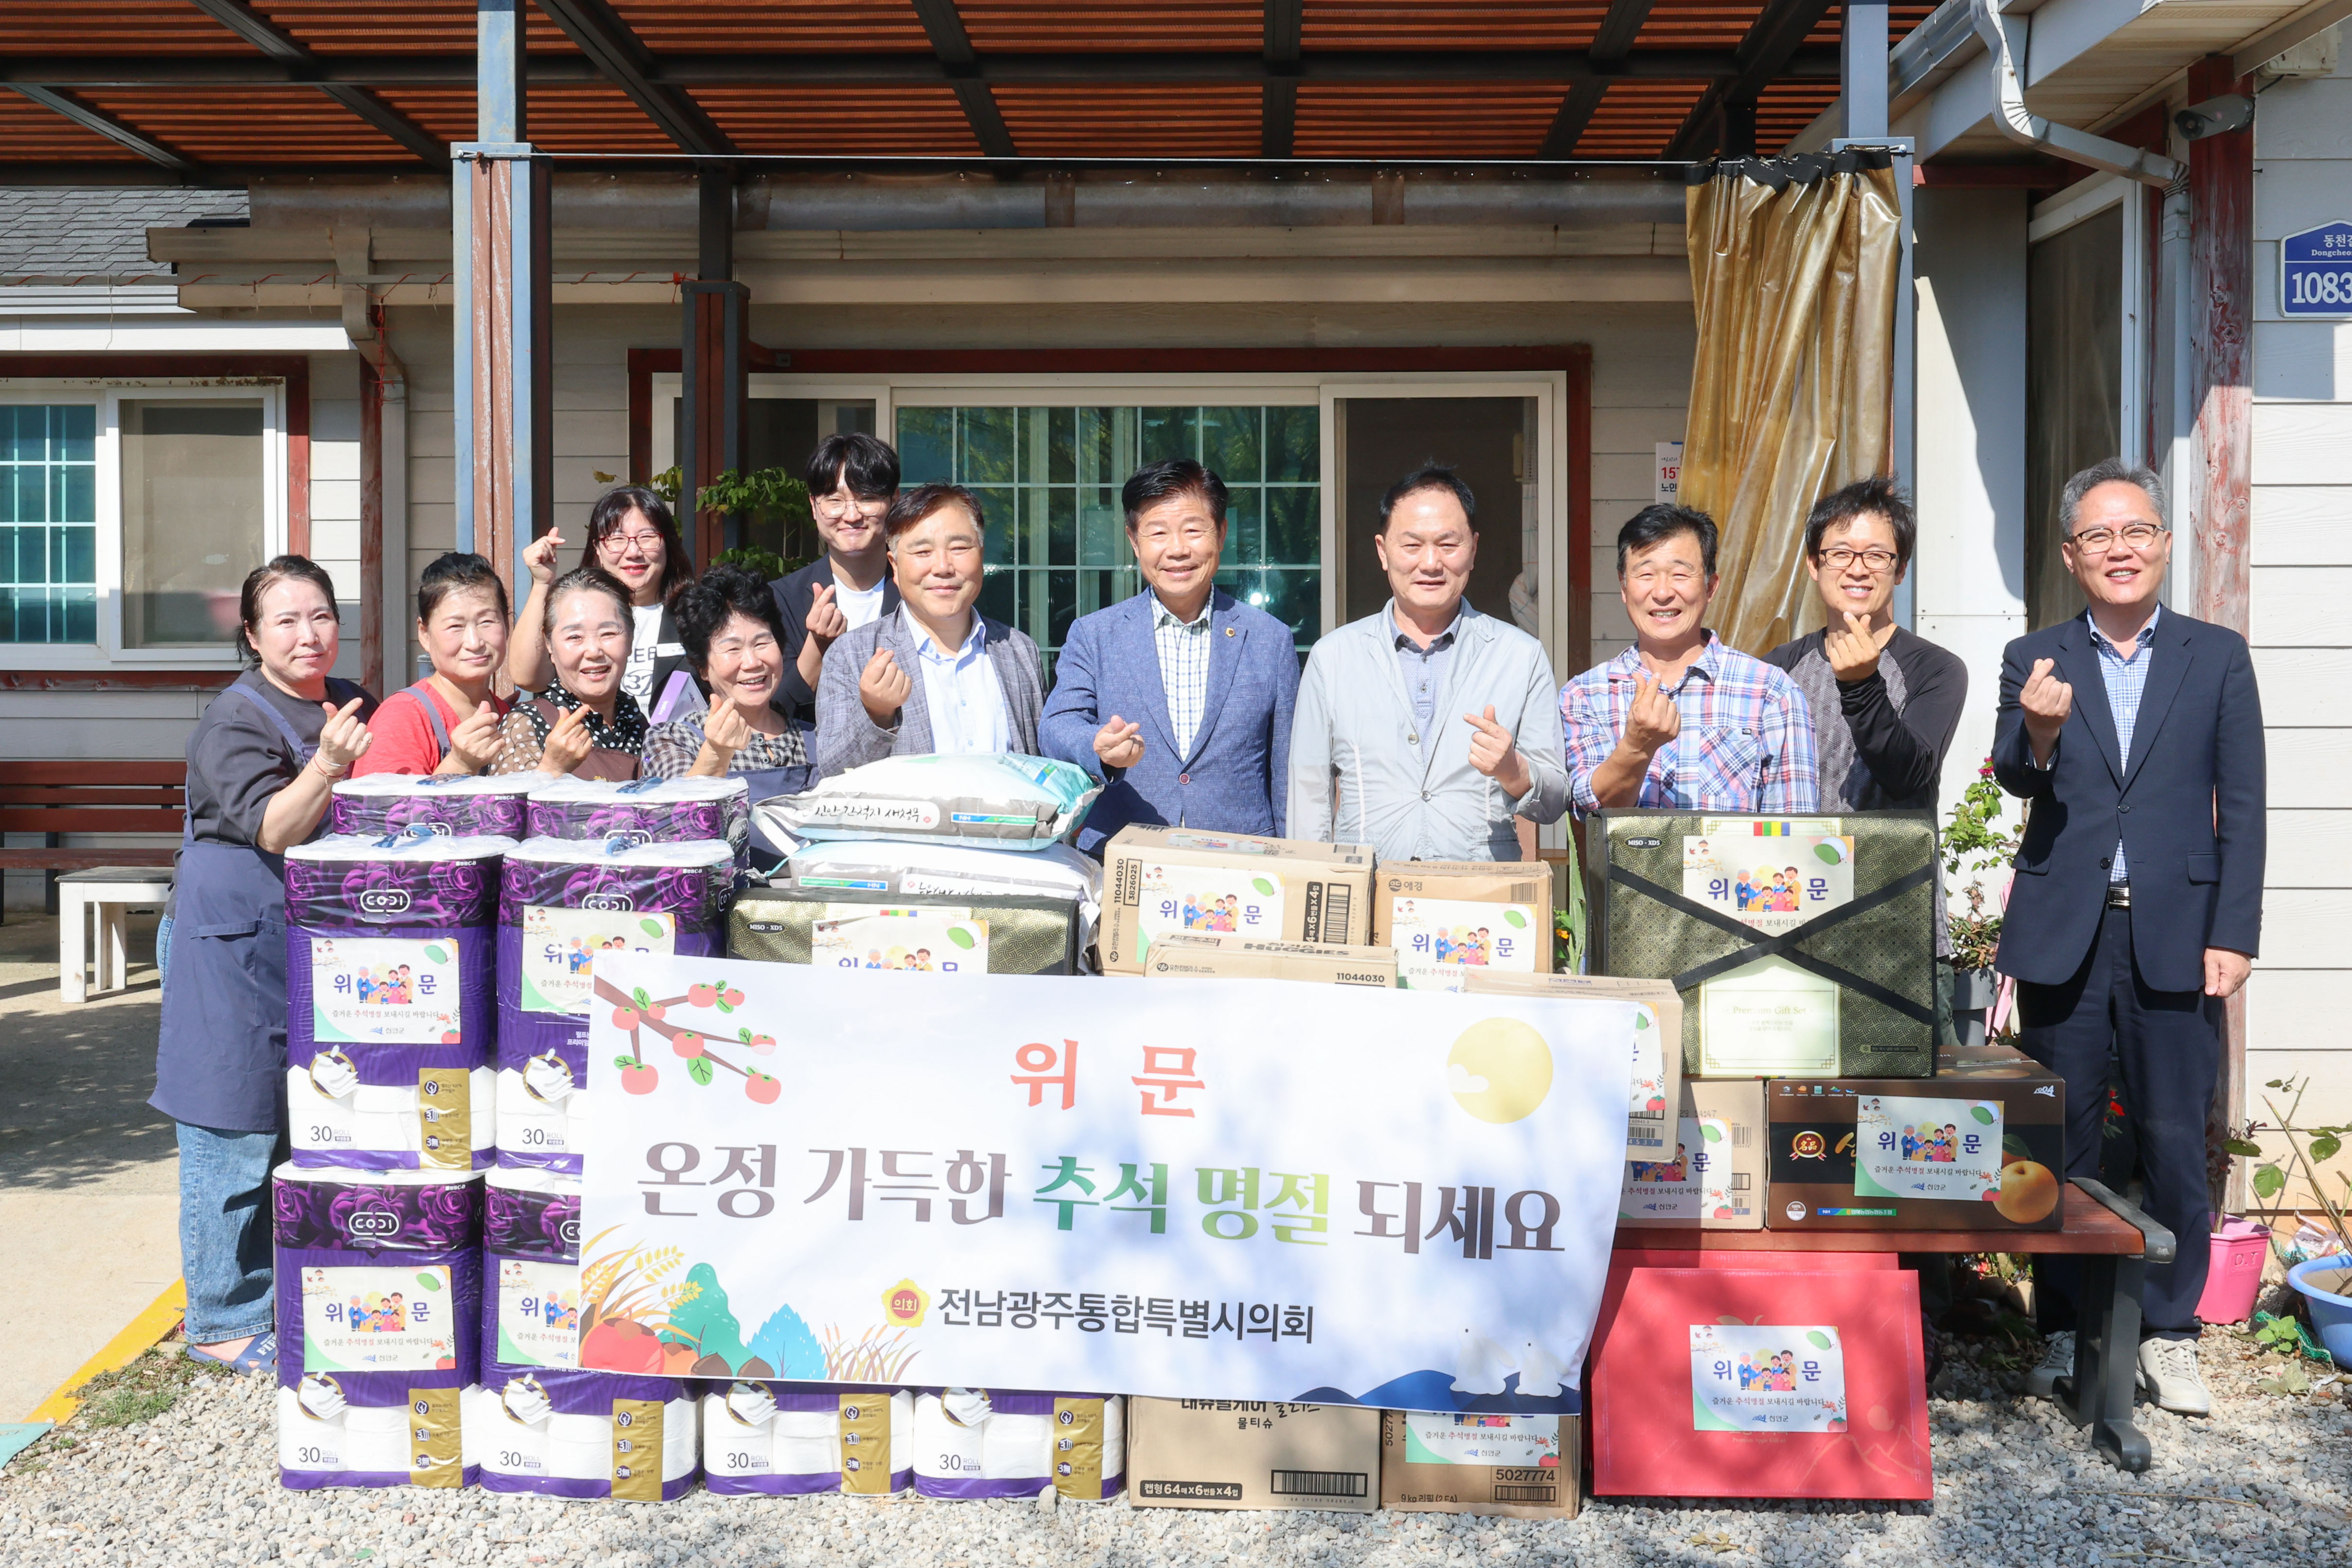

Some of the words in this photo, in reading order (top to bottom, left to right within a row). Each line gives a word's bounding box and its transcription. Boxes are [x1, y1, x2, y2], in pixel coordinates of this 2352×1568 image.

[2311, 249, 2352, 257] Dongcheo
[1661, 467, 1680, 479] 15
[1114, 859, 1124, 903] 11044030
[1129, 864, 1138, 901] 3826025
[1404, 881, 1423, 891] 애경
[1708, 878, 1728, 901] 위
[1807, 878, 1829, 901] 문
[366, 896, 403, 906] CODI
[588, 901, 626, 910] CODI
[1160, 900, 1178, 919] 위
[1244, 905, 1262, 924] 문
[1741, 919, 1763, 927] 석명절
[1765, 919, 1796, 927] 보내시길
[1243, 943, 1350, 955] HUGGIES
[1412, 934, 1430, 953] 위
[1496, 938, 1514, 957] 문
[334, 974, 351, 994] 위
[418, 974, 437, 994] 문
[1337, 973, 1385, 983] 11044030
[354, 1010, 381, 1018] 추석명절
[1010, 1038, 1078, 1110] 위
[1131, 1045, 1205, 1118] 문
[311, 1126, 332, 1141] 30
[522, 1128, 544, 1144] 30
[1799, 1140, 1817, 1151] 名品
[1878, 1132, 1896, 1151] 위
[1962, 1134, 1982, 1153] 문
[1692, 1153, 1711, 1172] 문
[1897, 1166, 1924, 1175] 추석명절
[1926, 1168, 1953, 1176] 보내시길
[1657, 1187, 1684, 1195] 보내시길
[637, 1141, 777, 1219] 온정
[803, 1146, 1012, 1225] 가득한
[1033, 1155, 1168, 1234] 추석
[1195, 1167, 1330, 1246] 명절
[1354, 1179, 1565, 1261] 되세요
[355, 1218, 393, 1229] CODI
[520, 1297, 539, 1317] 위
[893, 1297, 918, 1313] 의회
[325, 1302, 343, 1322] 위
[411, 1302, 430, 1322] 문
[938, 1287, 1314, 1344] 전남광주통합특별시의회
[346, 1338, 374, 1347] 추석명절
[377, 1338, 404, 1346] 보내시길
[539, 1333, 568, 1343] 추석명절
[1713, 1360, 1732, 1380] 위
[1802, 1361, 1821, 1381] 문
[1712, 1397, 1733, 1405] 즐거운
[1736, 1397, 1764, 1406] 추석명절
[1767, 1397, 1795, 1406] 보내시길
[1238, 1417, 1273, 1429] 물티슈
[1425, 1431, 1446, 1440] 즐거운
[1448, 1432, 1477, 1441] 추석명절
[1480, 1432, 1508, 1442] 보내시길
[299, 1447, 320, 1462] 30
[500, 1451, 521, 1466] 30
[727, 1453, 748, 1468] 30
[939, 1454, 961, 1470] 30
[1496, 1469, 1555, 1481] 5027774
[1145, 1483, 1163, 1494] 캡형
[1419, 1494, 1433, 1502] 리필
